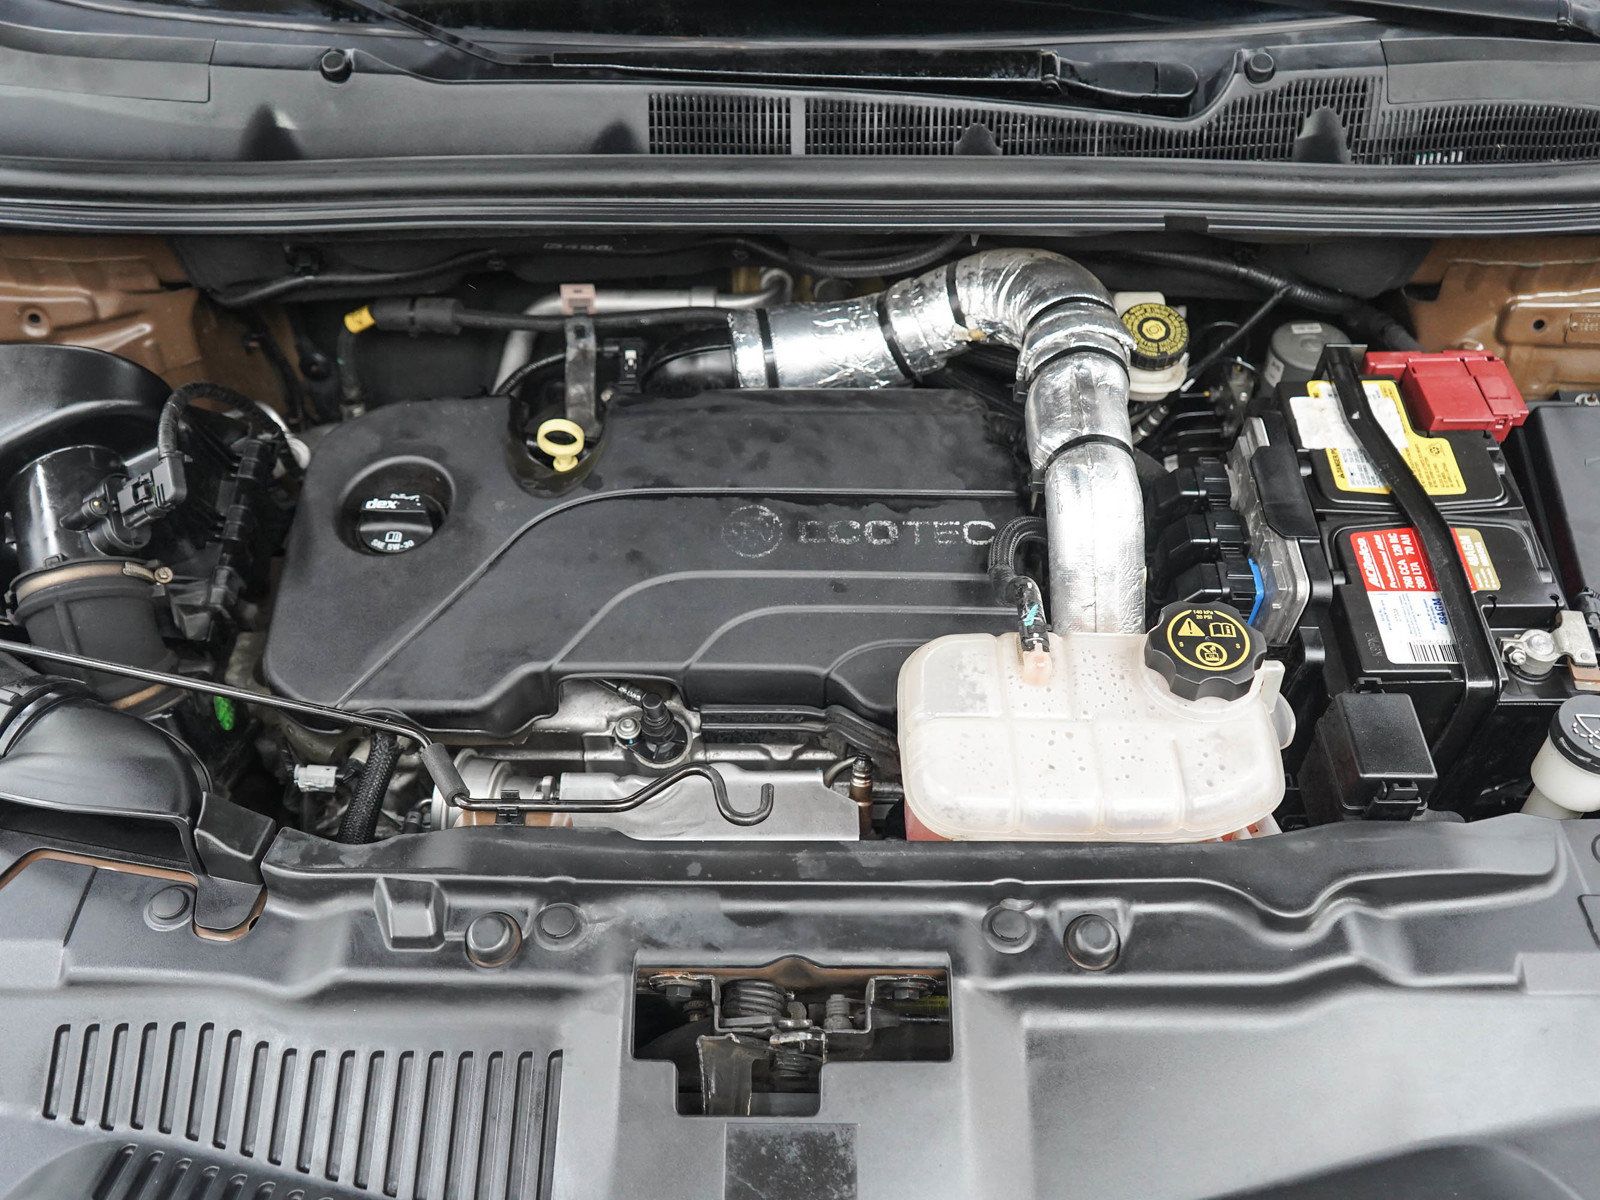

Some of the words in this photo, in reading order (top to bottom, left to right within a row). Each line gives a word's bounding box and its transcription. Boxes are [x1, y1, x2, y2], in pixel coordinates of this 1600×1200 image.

[797, 520, 996, 545] ECOTEC
[371, 539, 386, 550] SAE
[387, 540, 415, 550] 5W-30
[1400, 534, 1412, 546] AH
[1391, 544, 1404, 556] 120
[1404, 546, 1415, 555] 70
[1357, 537, 1381, 588] ACDelco
[1397, 559, 1410, 575] CCA
[1409, 562, 1422, 575] LTA
